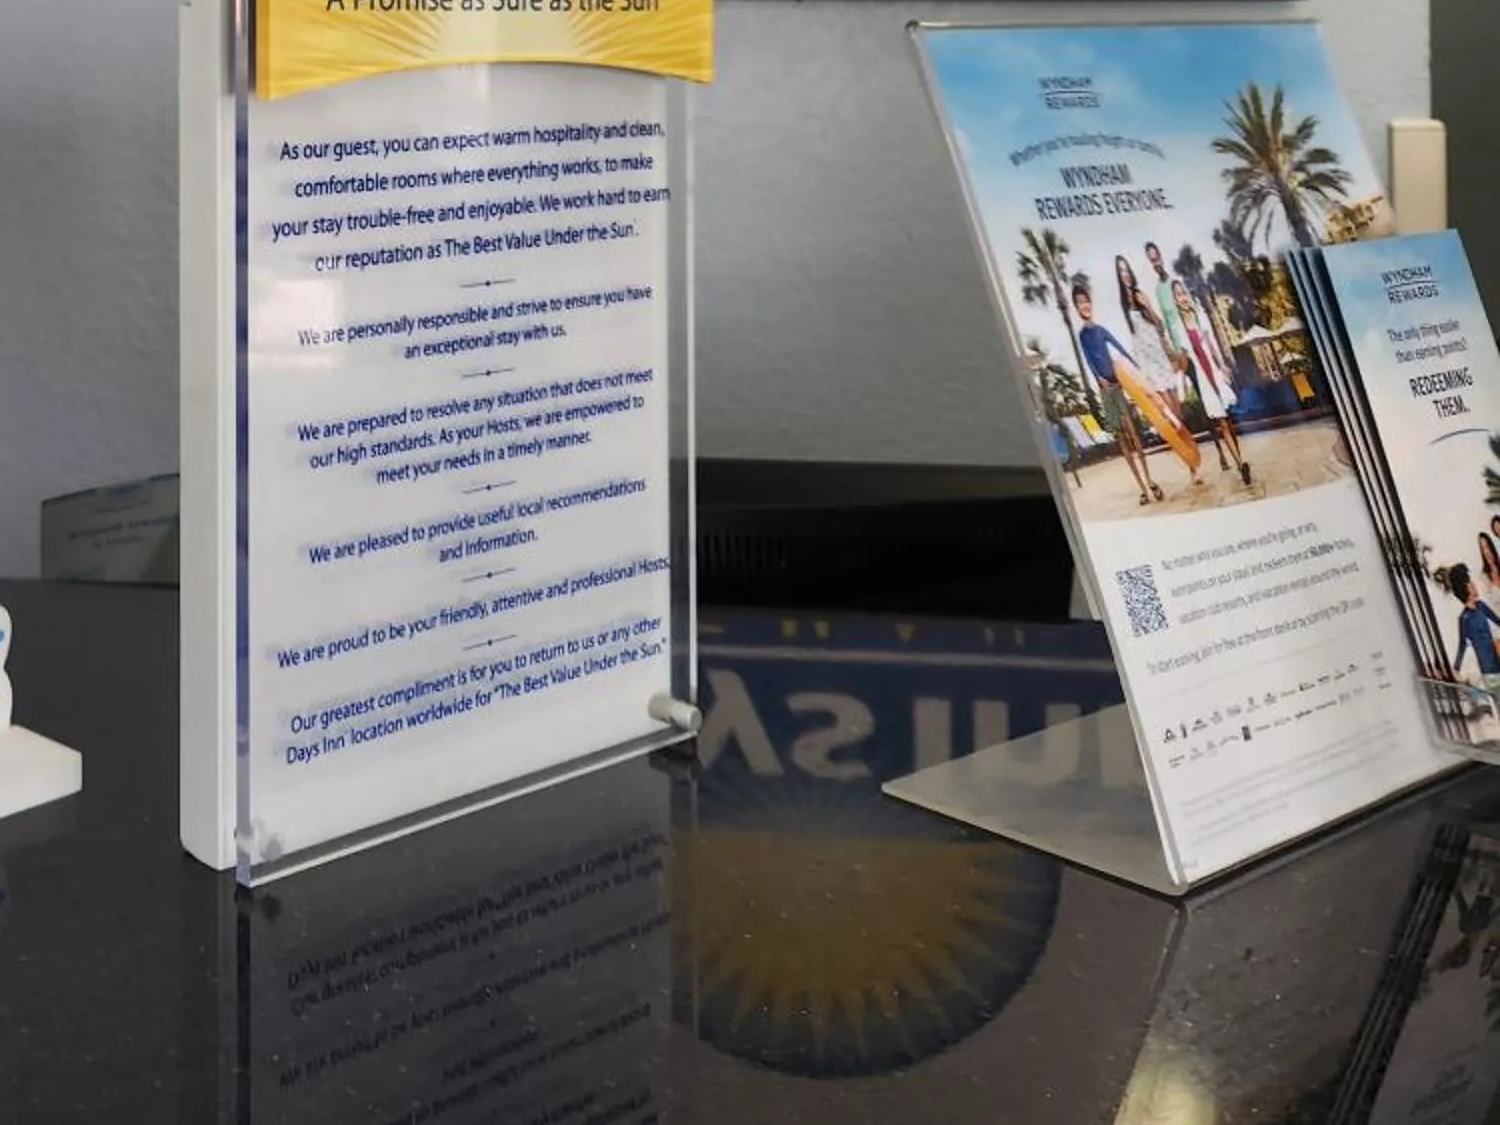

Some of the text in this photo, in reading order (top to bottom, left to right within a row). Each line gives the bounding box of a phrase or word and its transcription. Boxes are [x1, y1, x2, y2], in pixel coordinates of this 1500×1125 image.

[280, 130, 530, 160] As our you can expect warm
[295, 153, 652, 197] comfortable rooms where everything to make
[1060, 163, 1132, 189] WYNDHAM
[273, 188, 640, 243] your stay and We work hard to
[1034, 194, 1100, 220] REWARDS
[315, 225, 609, 271] our reputation as The Best Value Under the
[1381, 265, 1431, 284] WYNDHAM
[1388, 286, 1438, 303] REWARDS
[298, 285, 652, 346] We are personally responsible and strive to ensure you have
[404, 324, 548, 359] an exceptional stay with
[1410, 367, 1473, 397] REDEEMING
[298, 373, 623, 441] We are prepared to resolve any situation that does not
[310, 395, 644, 469] our high As your we are empowered to
[377, 438, 544, 484] meet your needs in a timely
[309, 496, 543, 564] We are pleased to provide useful local
[439, 539, 462, 562] and
[278, 563, 635, 668] We are proud to be your attentive and professional
[291, 618, 660, 734] Our greatest compliment is for you to return to us or any other
[287, 648, 638, 764] Days location worldwide for Best Value Under the
